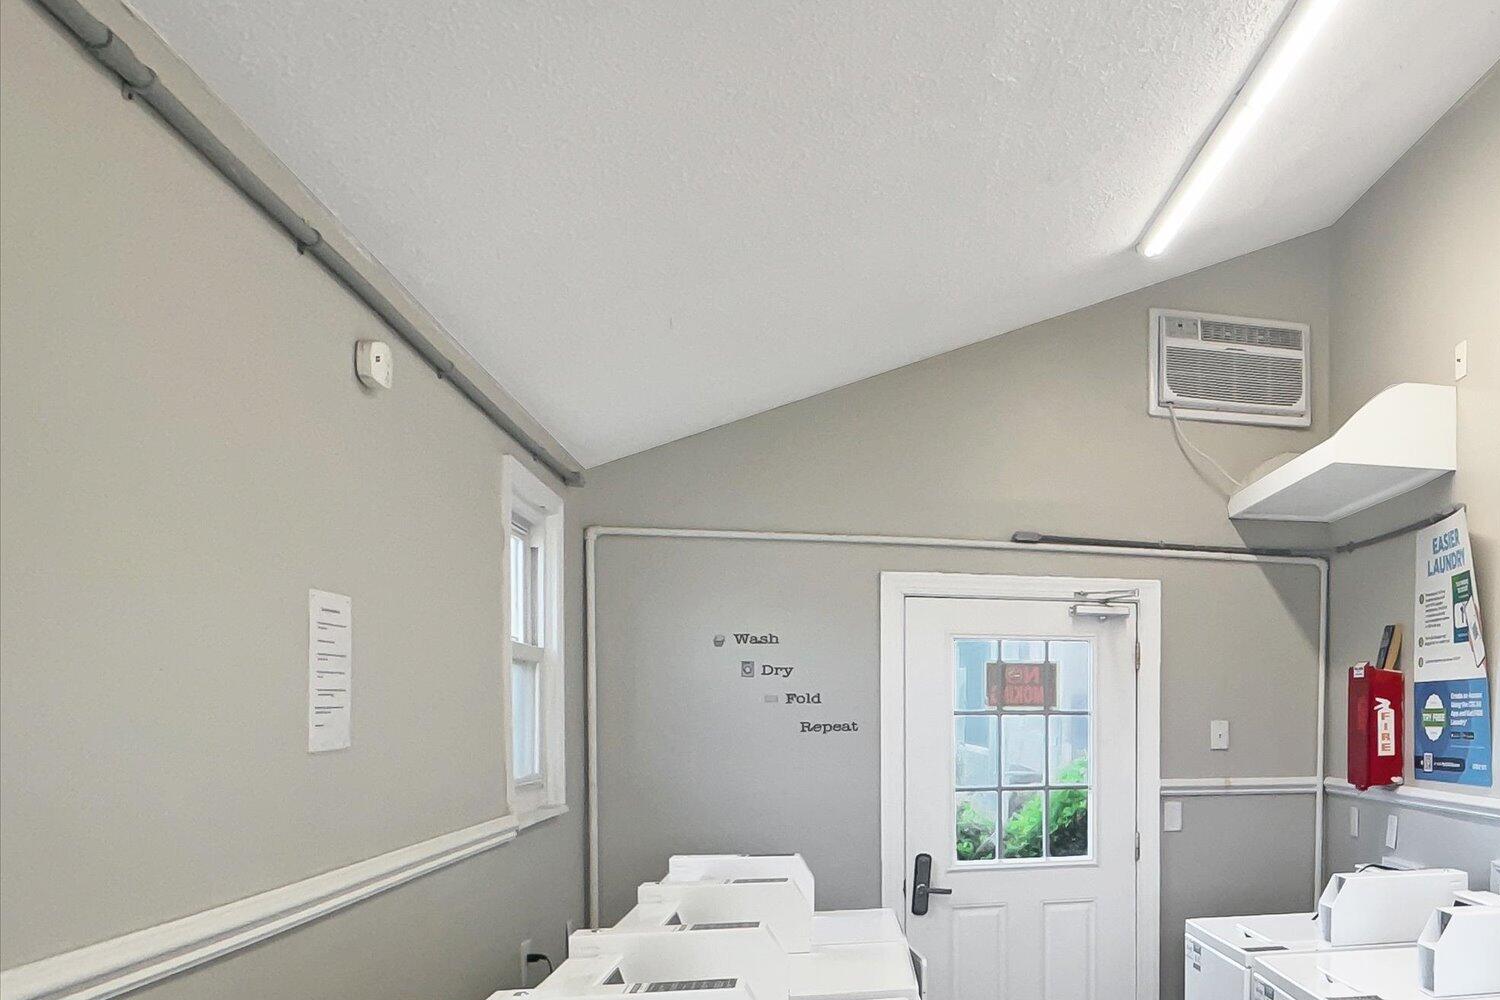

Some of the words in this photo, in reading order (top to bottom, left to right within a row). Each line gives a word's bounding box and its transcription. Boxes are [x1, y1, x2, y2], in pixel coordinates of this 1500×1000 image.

[1432, 528, 1460, 554] EASIER
[1427, 547, 1465, 577] LAUNDRY
[733, 633, 780, 645] Wash
[761, 664, 794, 678] Dry
[785, 693, 822, 704] Fold
[800, 721, 859, 734] Repeat
[1381, 711, 1391, 752] FIRE
